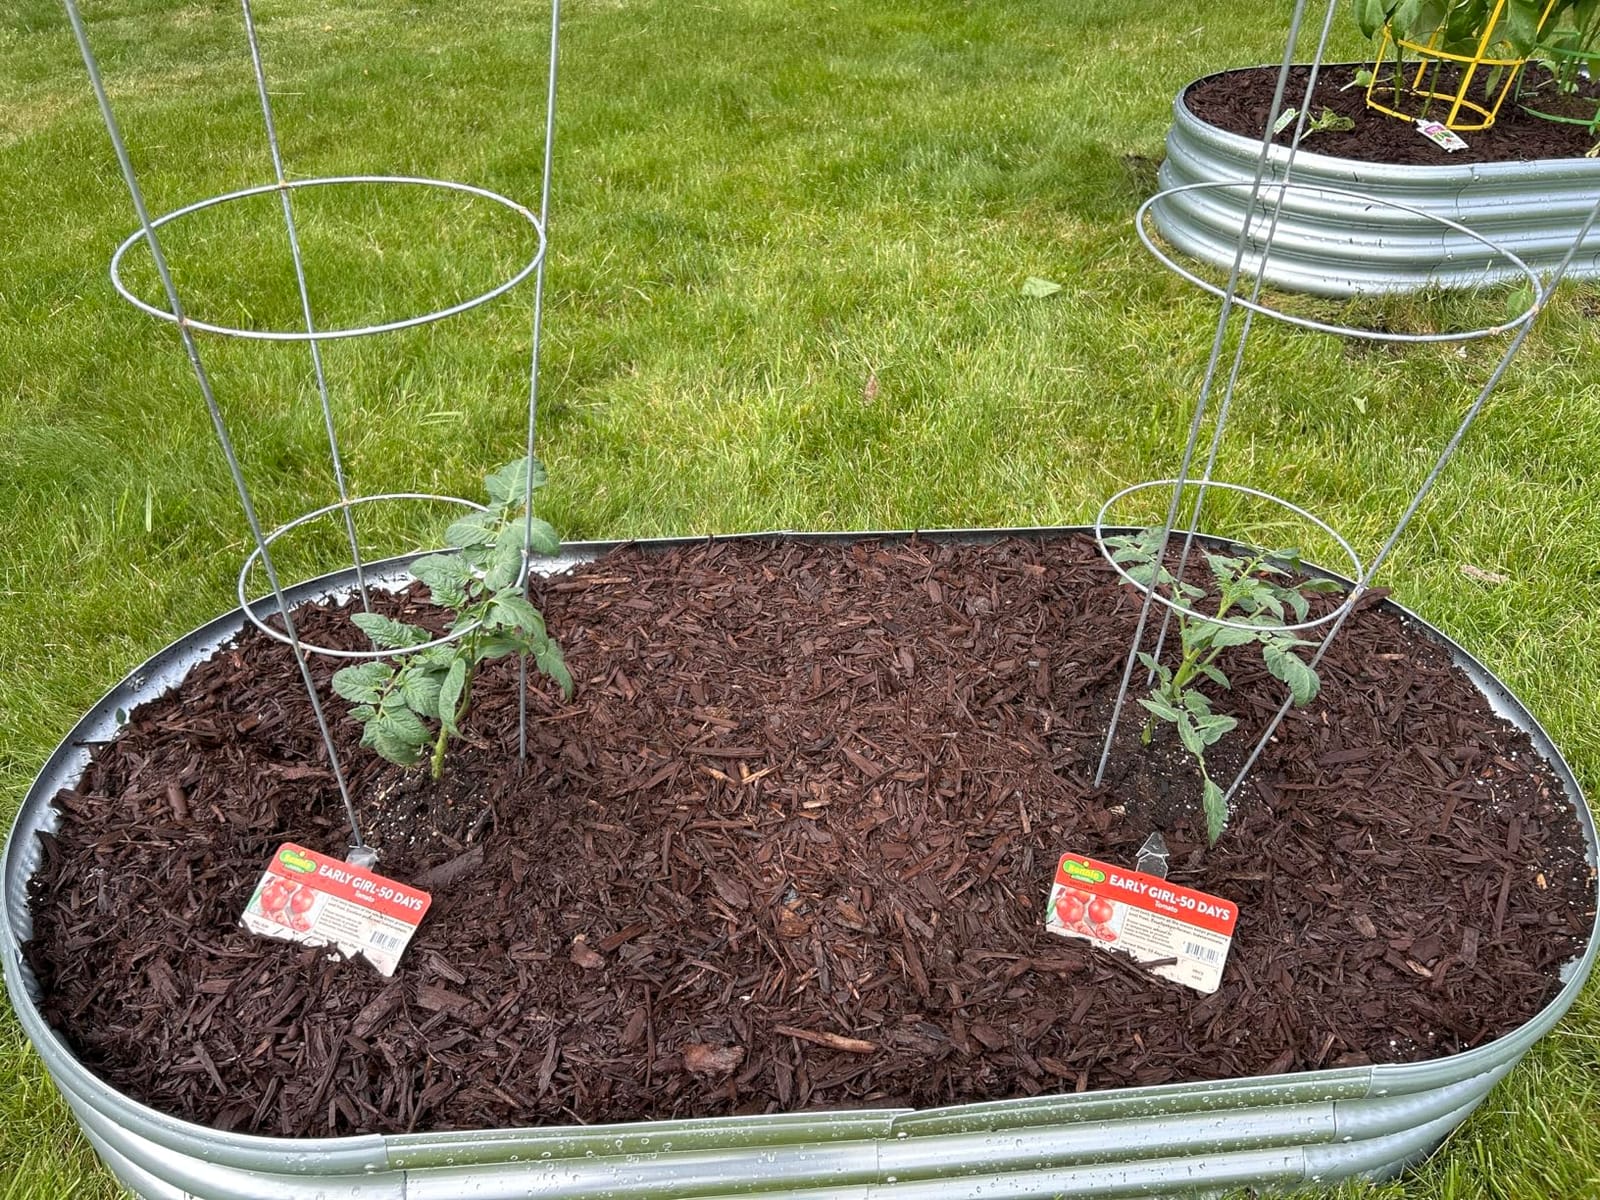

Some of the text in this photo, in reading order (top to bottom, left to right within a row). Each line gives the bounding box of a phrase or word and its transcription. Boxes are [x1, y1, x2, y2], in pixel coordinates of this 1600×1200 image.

[318, 864, 353, 885] EARLY
[352, 877, 394, 900] GIRL-50
[393, 892, 424, 911] DAYS
[1109, 874, 1148, 895] EARLY
[1148, 887, 1196, 910] GIRL-50
[1197, 901, 1231, 921] DAYS
[1154, 900, 1179, 913] Tomato
